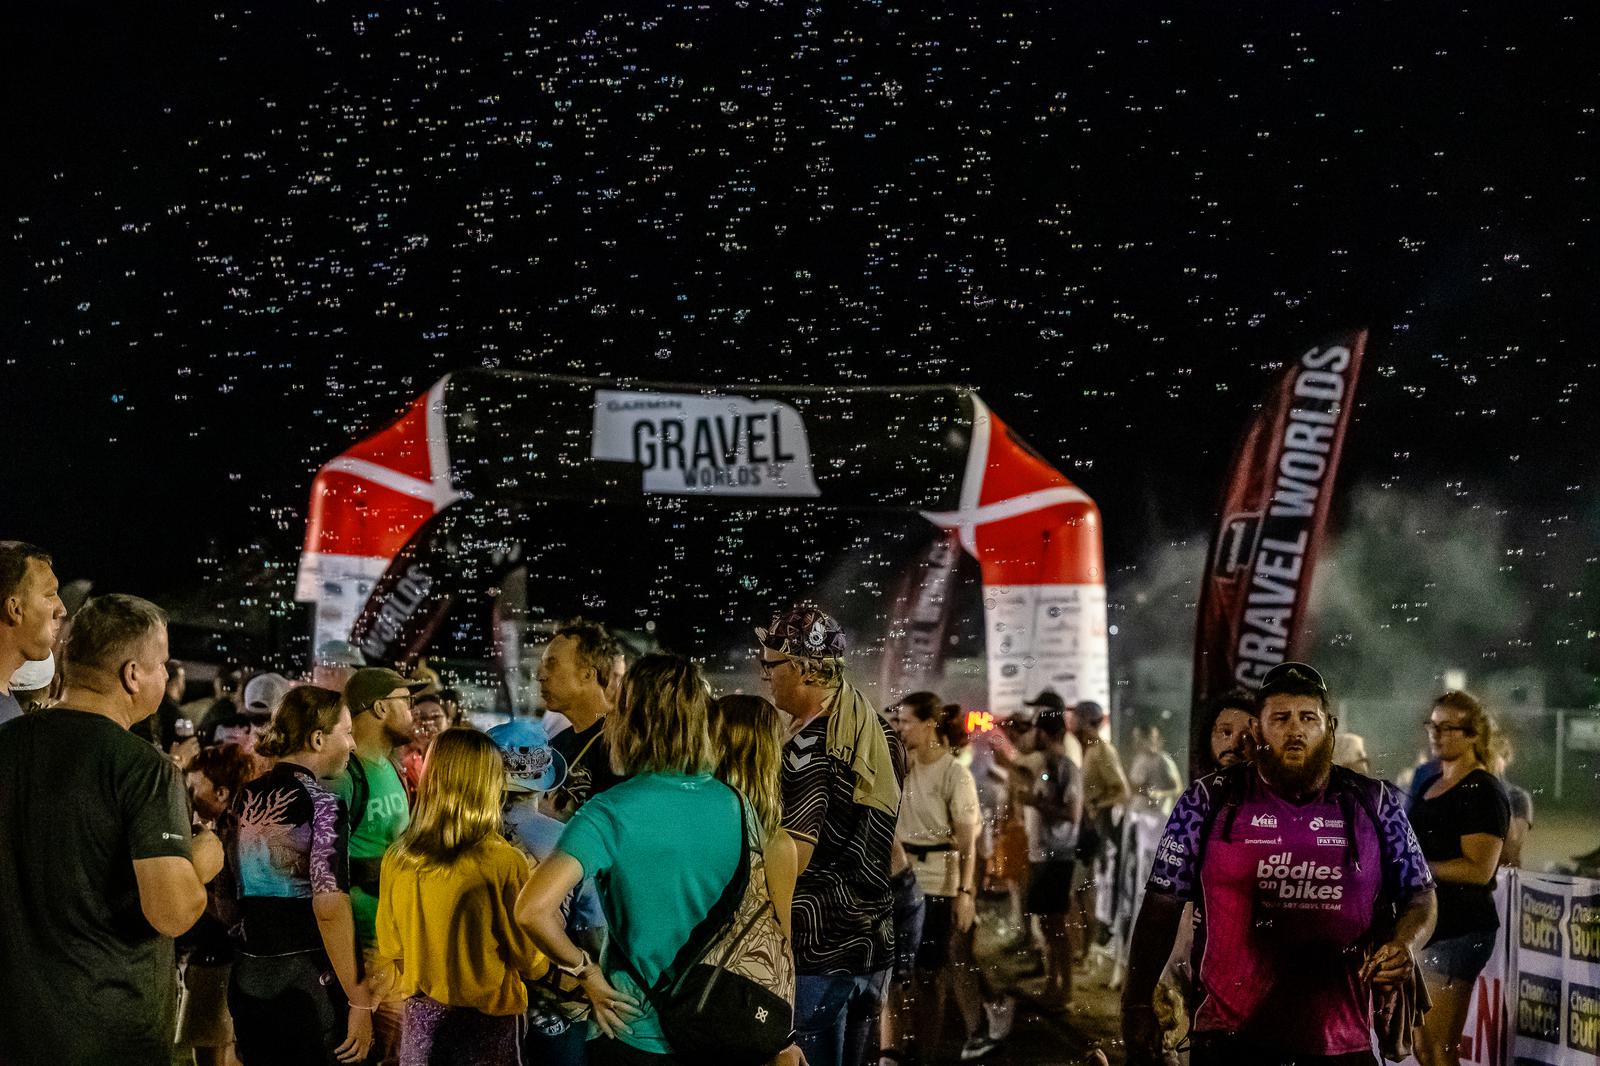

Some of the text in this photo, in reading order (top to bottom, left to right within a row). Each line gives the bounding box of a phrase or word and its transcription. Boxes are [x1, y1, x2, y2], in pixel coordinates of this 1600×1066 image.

[632, 410, 794, 470] GRAVEL
[683, 465, 762, 487] WORLDS
[1235, 345, 1351, 690] GRAVEL WORLDS
[367, 793, 404, 822] RID
[1244, 837, 1277, 845] Smartwool
[1268, 852, 1293, 865] all
[1256, 859, 1343, 880] bodies
[1258, 879, 1344, 900] on bikes
[1320, 903, 1342, 911] TEAM
